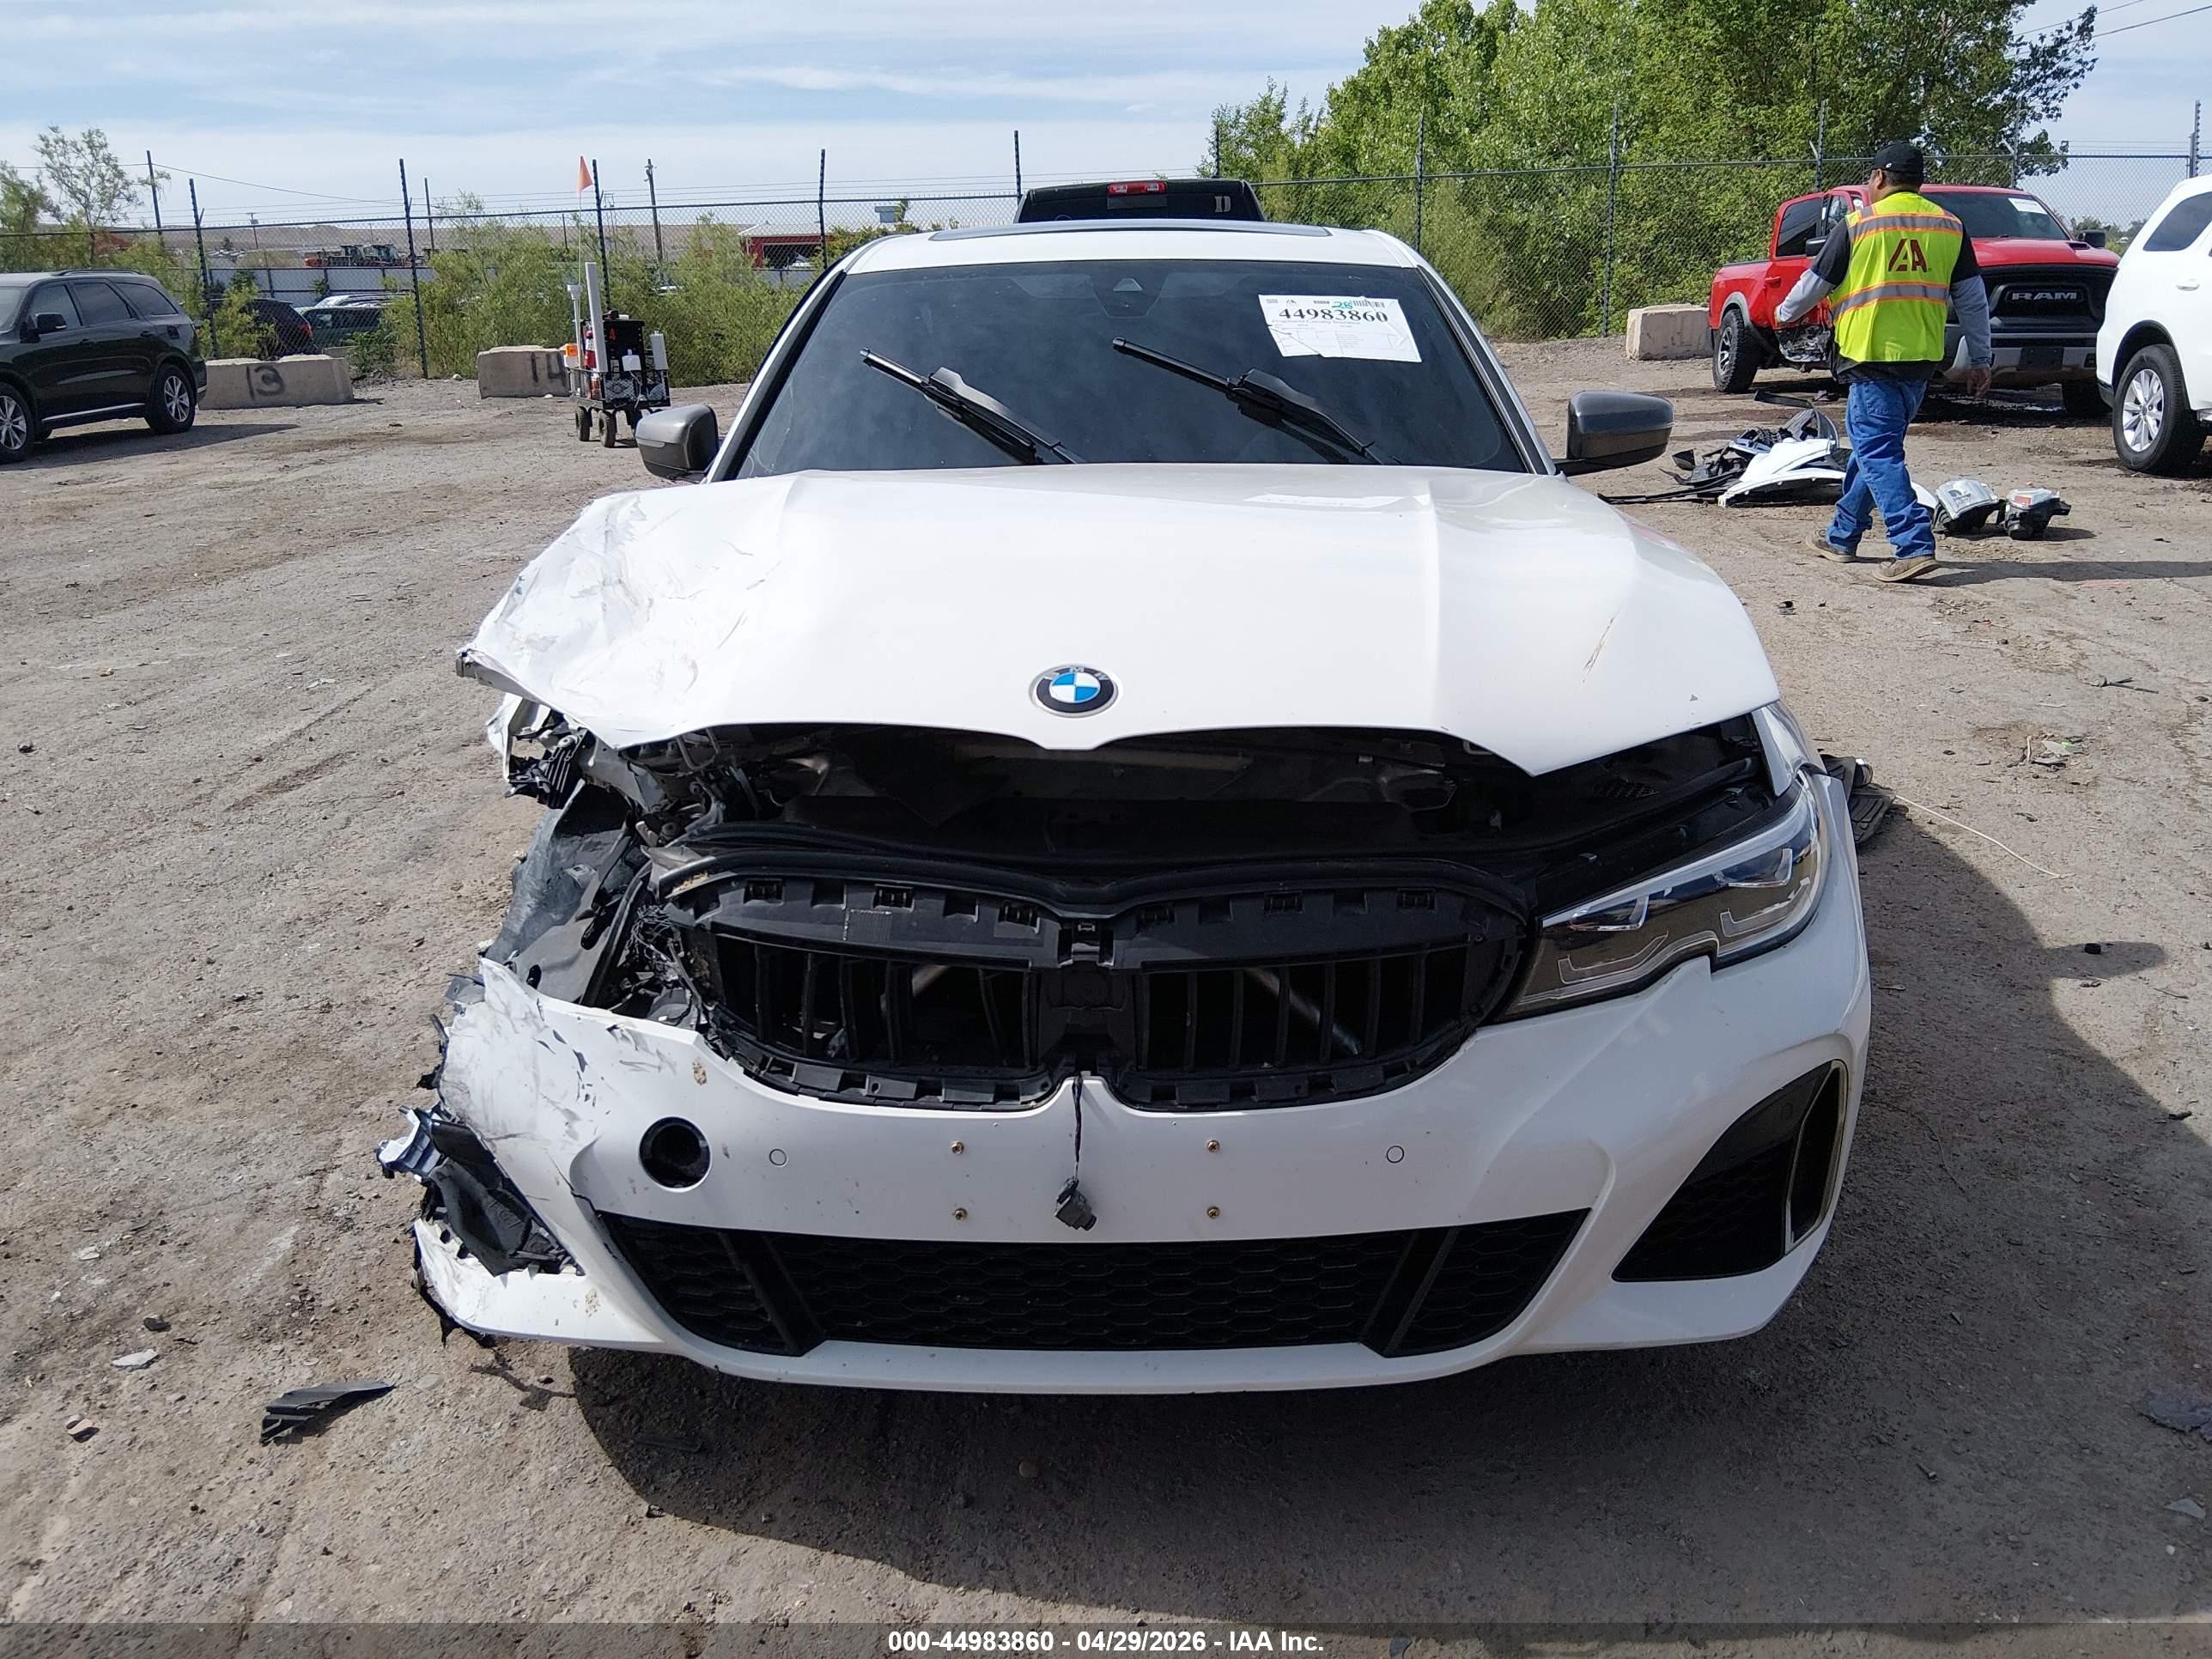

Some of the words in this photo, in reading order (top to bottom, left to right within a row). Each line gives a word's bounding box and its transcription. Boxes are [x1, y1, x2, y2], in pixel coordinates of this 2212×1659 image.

[1279, 308, 1389, 323] 44983860
[246, 365, 287, 400] 13
[531, 351, 566, 386] 14
